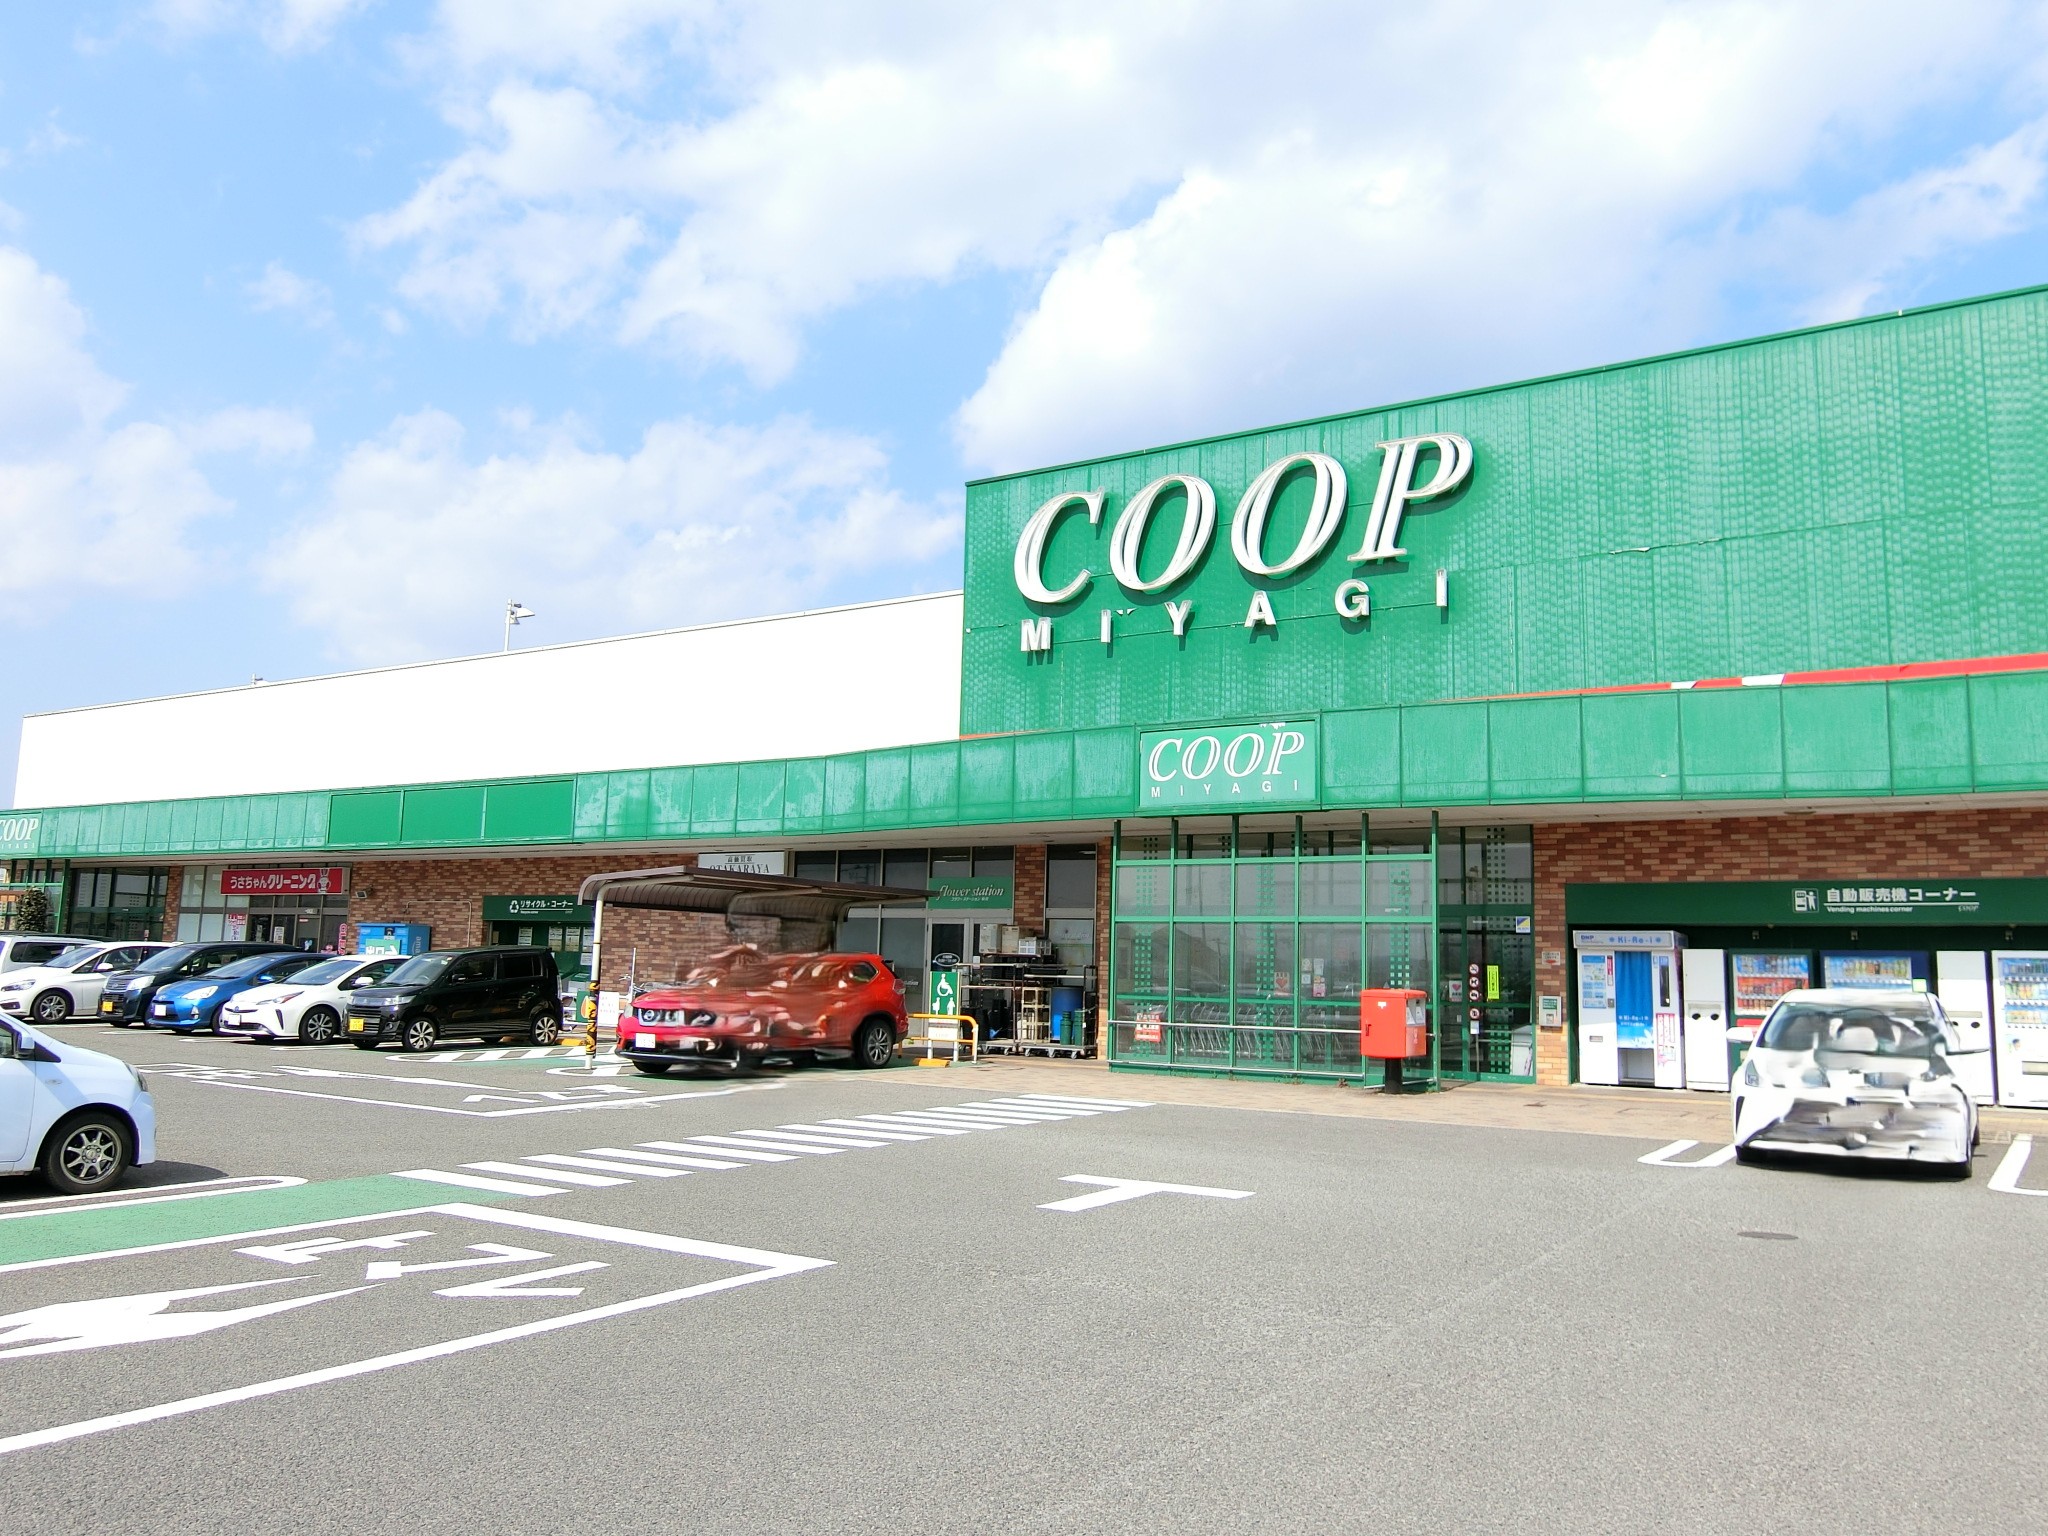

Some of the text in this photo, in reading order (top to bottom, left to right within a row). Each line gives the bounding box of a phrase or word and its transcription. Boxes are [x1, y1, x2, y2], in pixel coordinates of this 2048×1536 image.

[1014, 433, 1474, 603] COOP
[1020, 568, 1447, 652] MIYAGI
[1148, 731, 1305, 781] COOP
[1151, 779, 1298, 798] MIYAGI
[230, 873, 316, 890] うさちゃんクリーニング
[972, 884, 1004, 897] station
[1826, 888, 1977, 903] 自動販売機コーナー
[520, 900, 574, 908] リサイクル・コーナー
[1826, 906, 1855, 914] Vending
